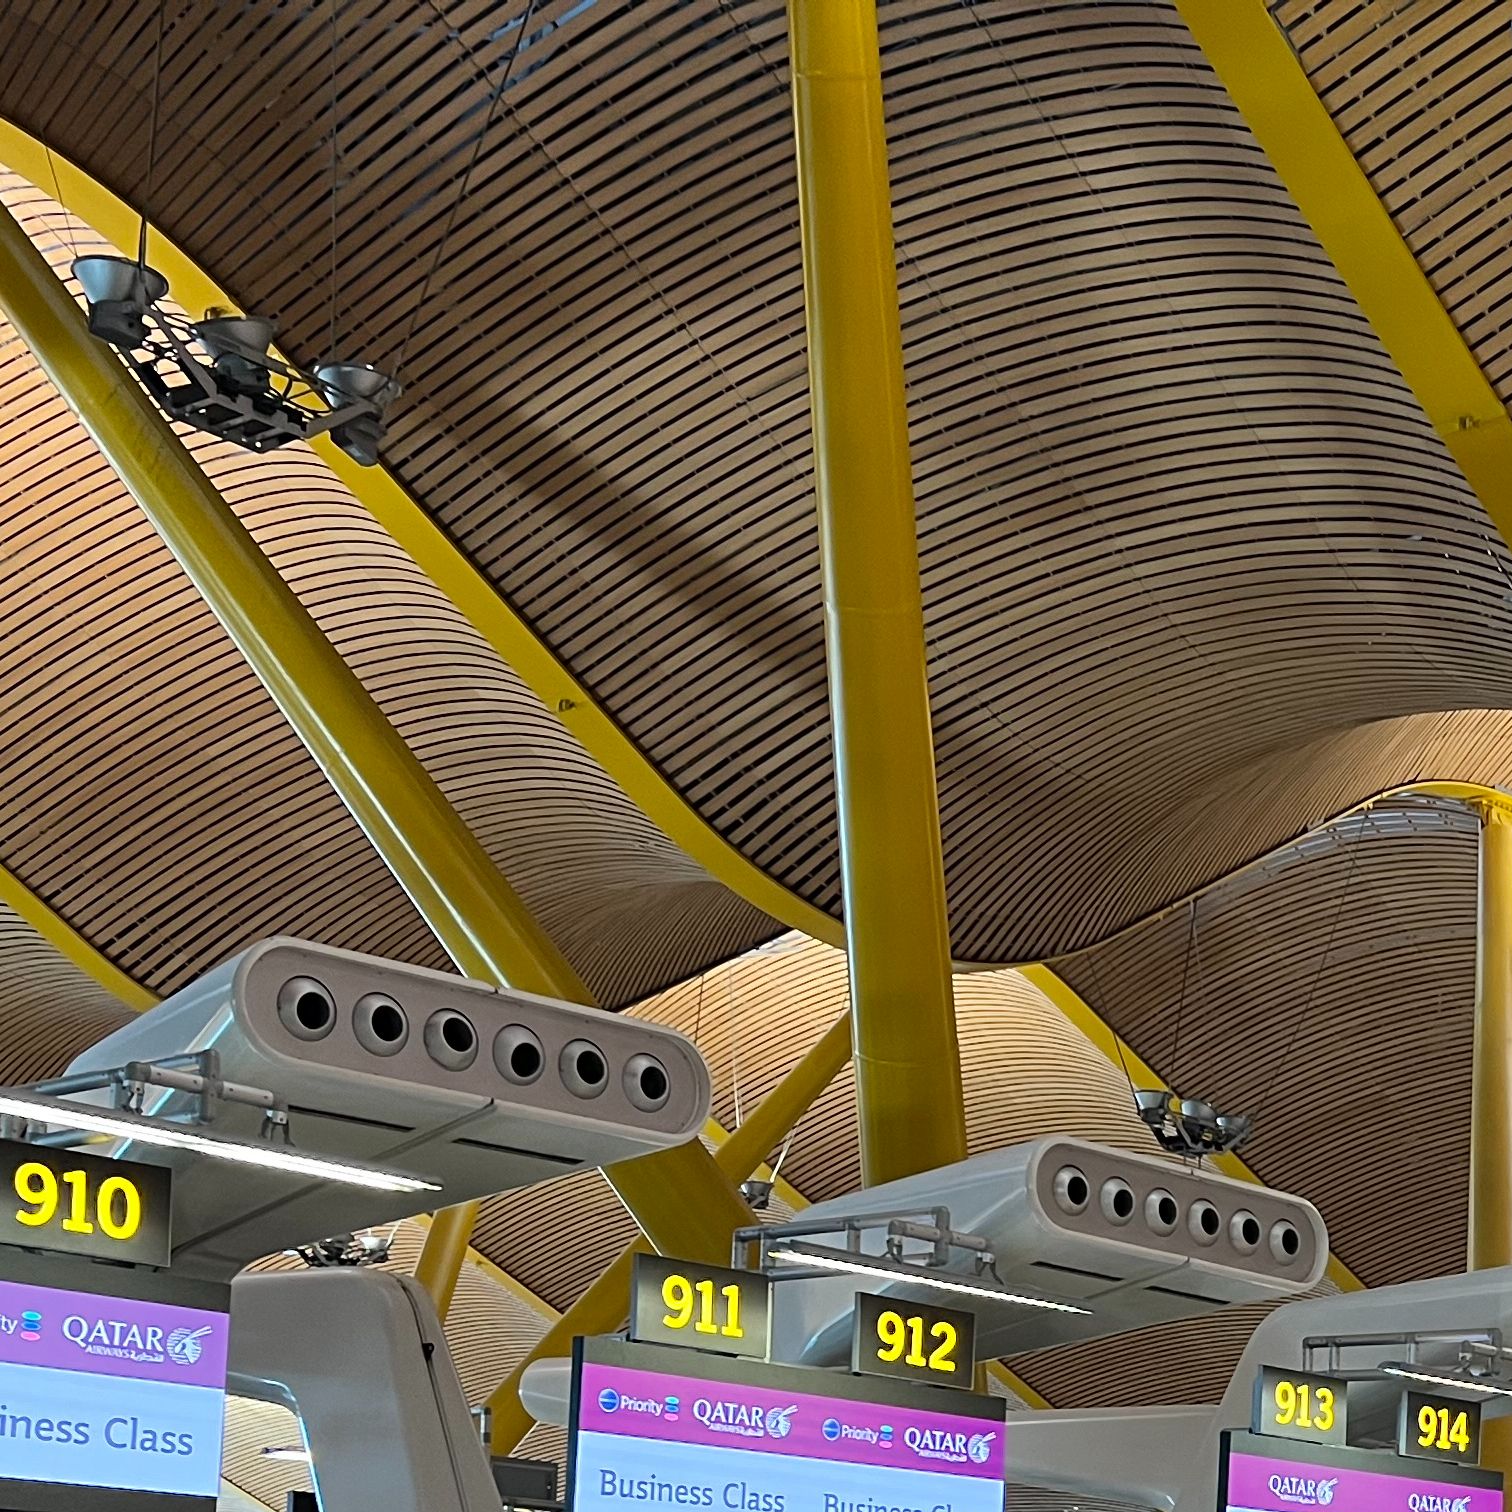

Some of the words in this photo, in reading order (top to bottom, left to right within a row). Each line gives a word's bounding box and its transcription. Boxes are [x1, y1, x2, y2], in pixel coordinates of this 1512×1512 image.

[14, 1162, 142, 1240] 910
[661, 1274, 744, 1338] 911
[62, 1316, 164, 1352] QATAR
[876, 1311, 957, 1372] 912
[620, 1395, 664, 1417] Priority
[693, 1399, 764, 1428] QATAR
[1274, 1381, 1335, 1431] 913
[0, 1404, 90, 1445] iness
[104, 1417, 194, 1456] Class
[841, 1425, 879, 1444] Priority
[904, 1427, 967, 1454] QATAR
[1418, 1405, 1470, 1452] 914
[599, 1470, 714, 1508] Business
[1268, 1475, 1317, 1498] QATAR
